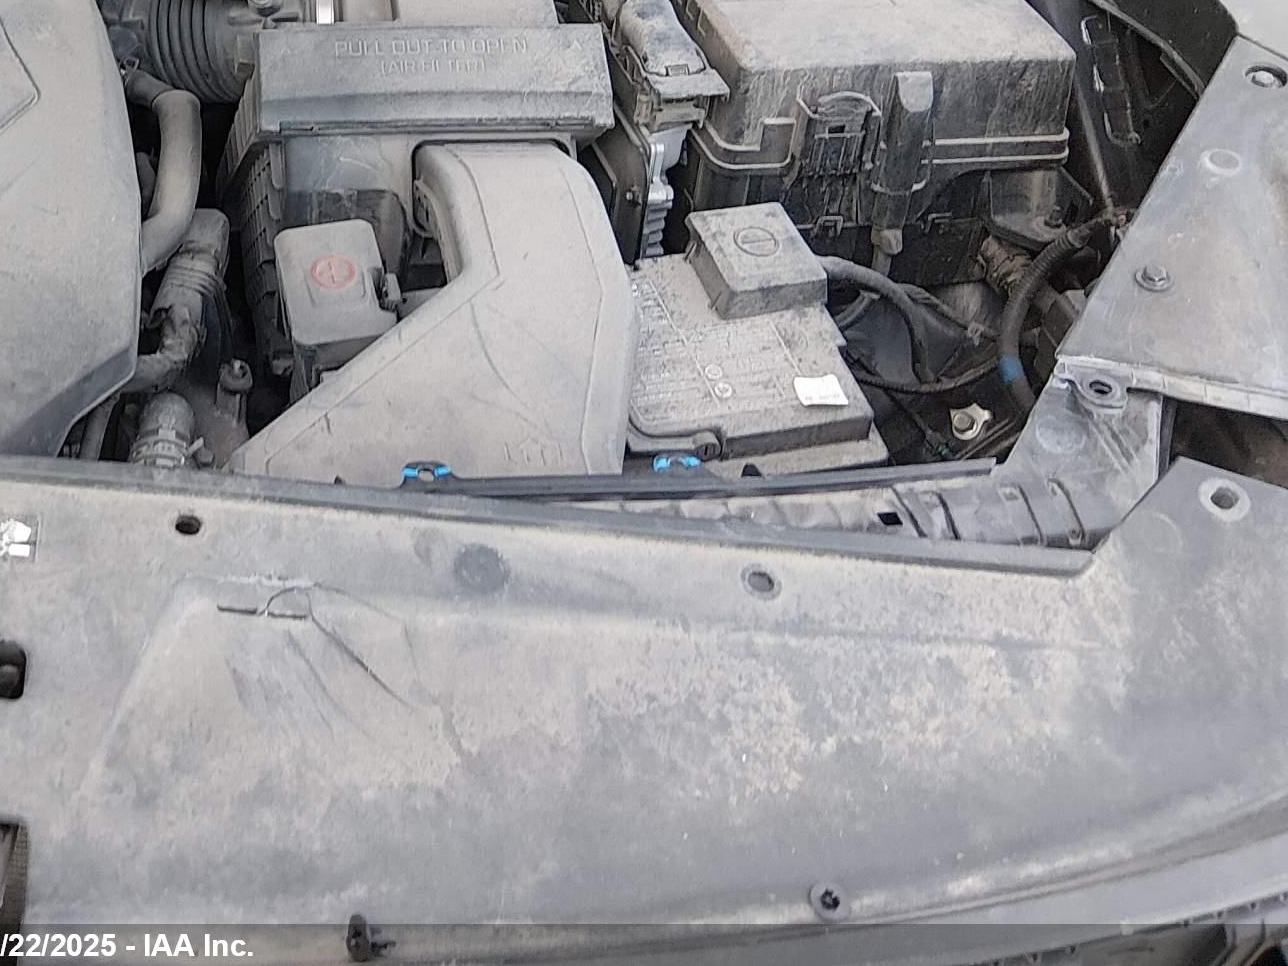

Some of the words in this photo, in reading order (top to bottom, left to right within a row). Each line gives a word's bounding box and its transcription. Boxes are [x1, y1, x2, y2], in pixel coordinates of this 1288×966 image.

[335, 39, 385, 58] PULL
[392, 39, 432, 55] OUT
[441, 39, 467, 54] TO
[472, 38, 527, 54] OPEN
